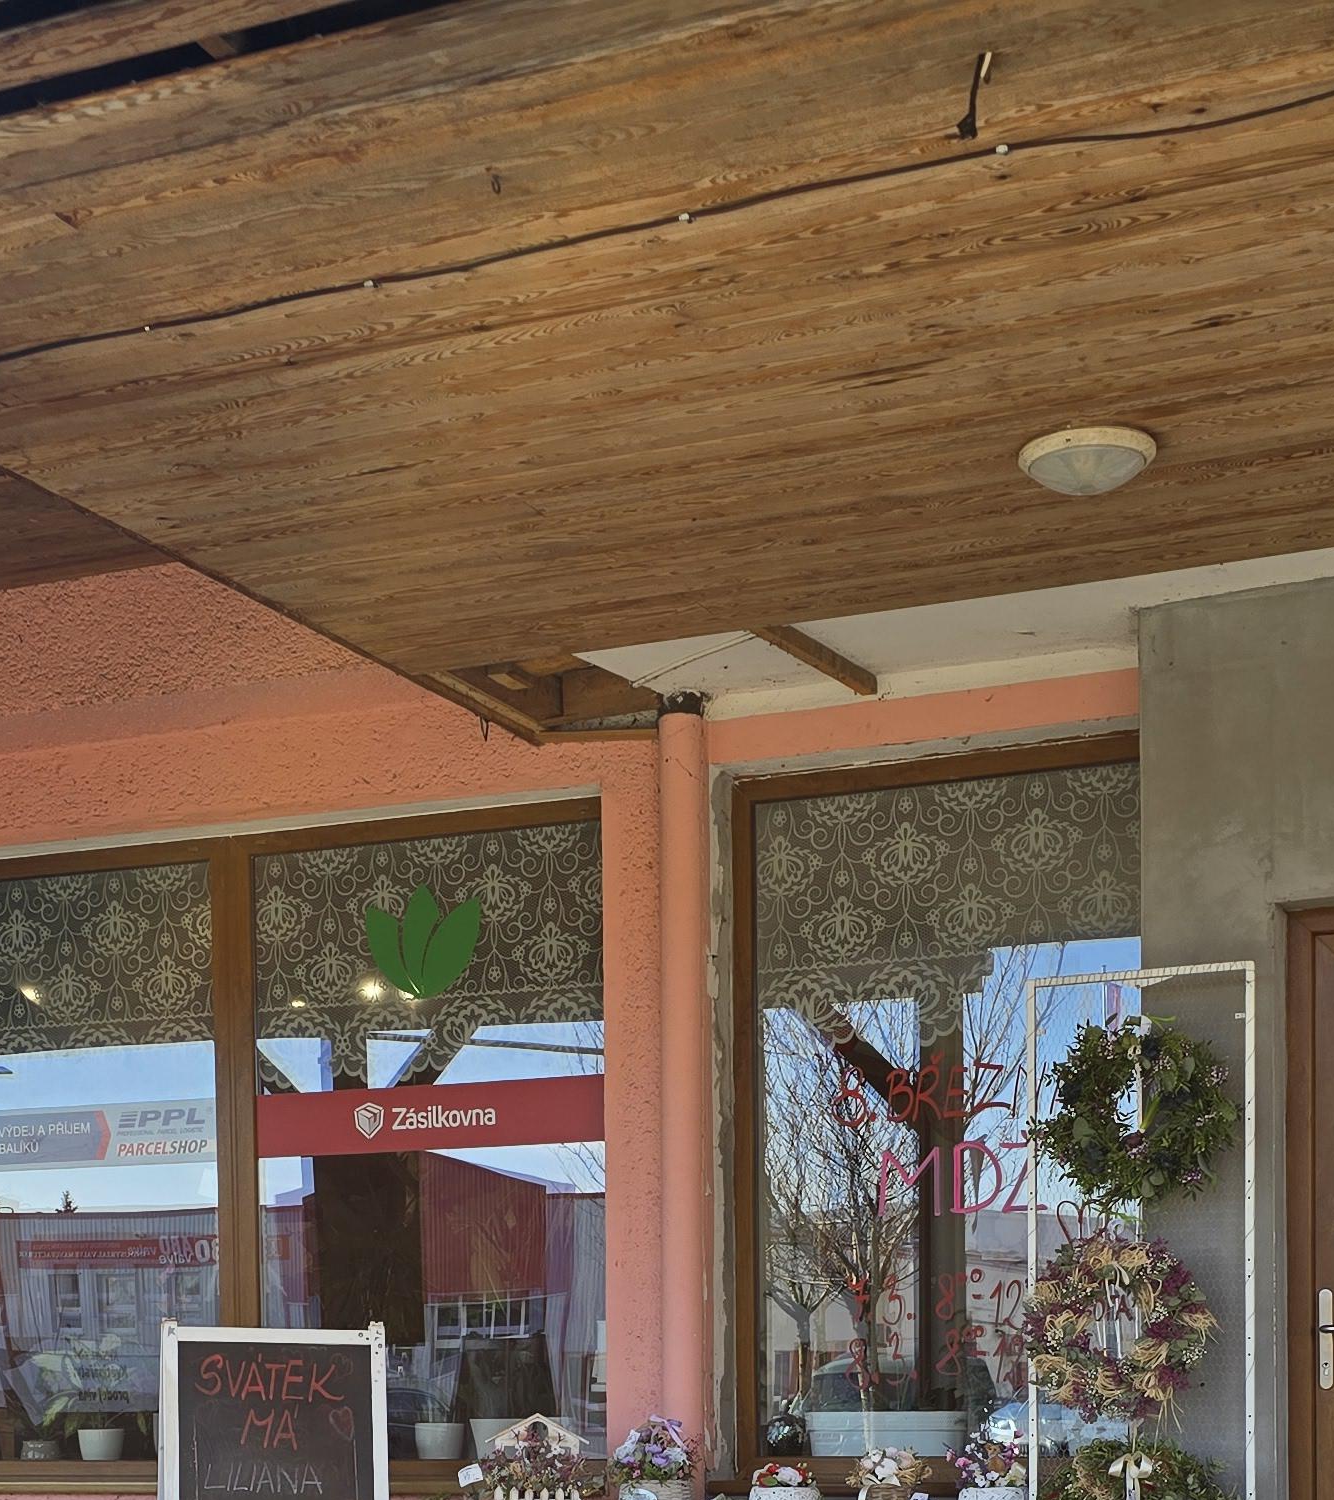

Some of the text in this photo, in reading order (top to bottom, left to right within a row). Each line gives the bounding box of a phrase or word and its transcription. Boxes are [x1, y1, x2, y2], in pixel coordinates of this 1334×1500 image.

[37, 1125, 46, 1136] A
[48, 1120, 91, 1136] PŘÍJEM
[138, 1108, 205, 1128] PPL
[391, 1105, 496, 1131] Zásilkovna
[118, 1140, 208, 1157] PARCELSHOP
[195, 1353, 345, 1402] SVÁTEK
[240, 1404, 299, 1450] MÁ
[204, 1463, 323, 1495] LILIANA
